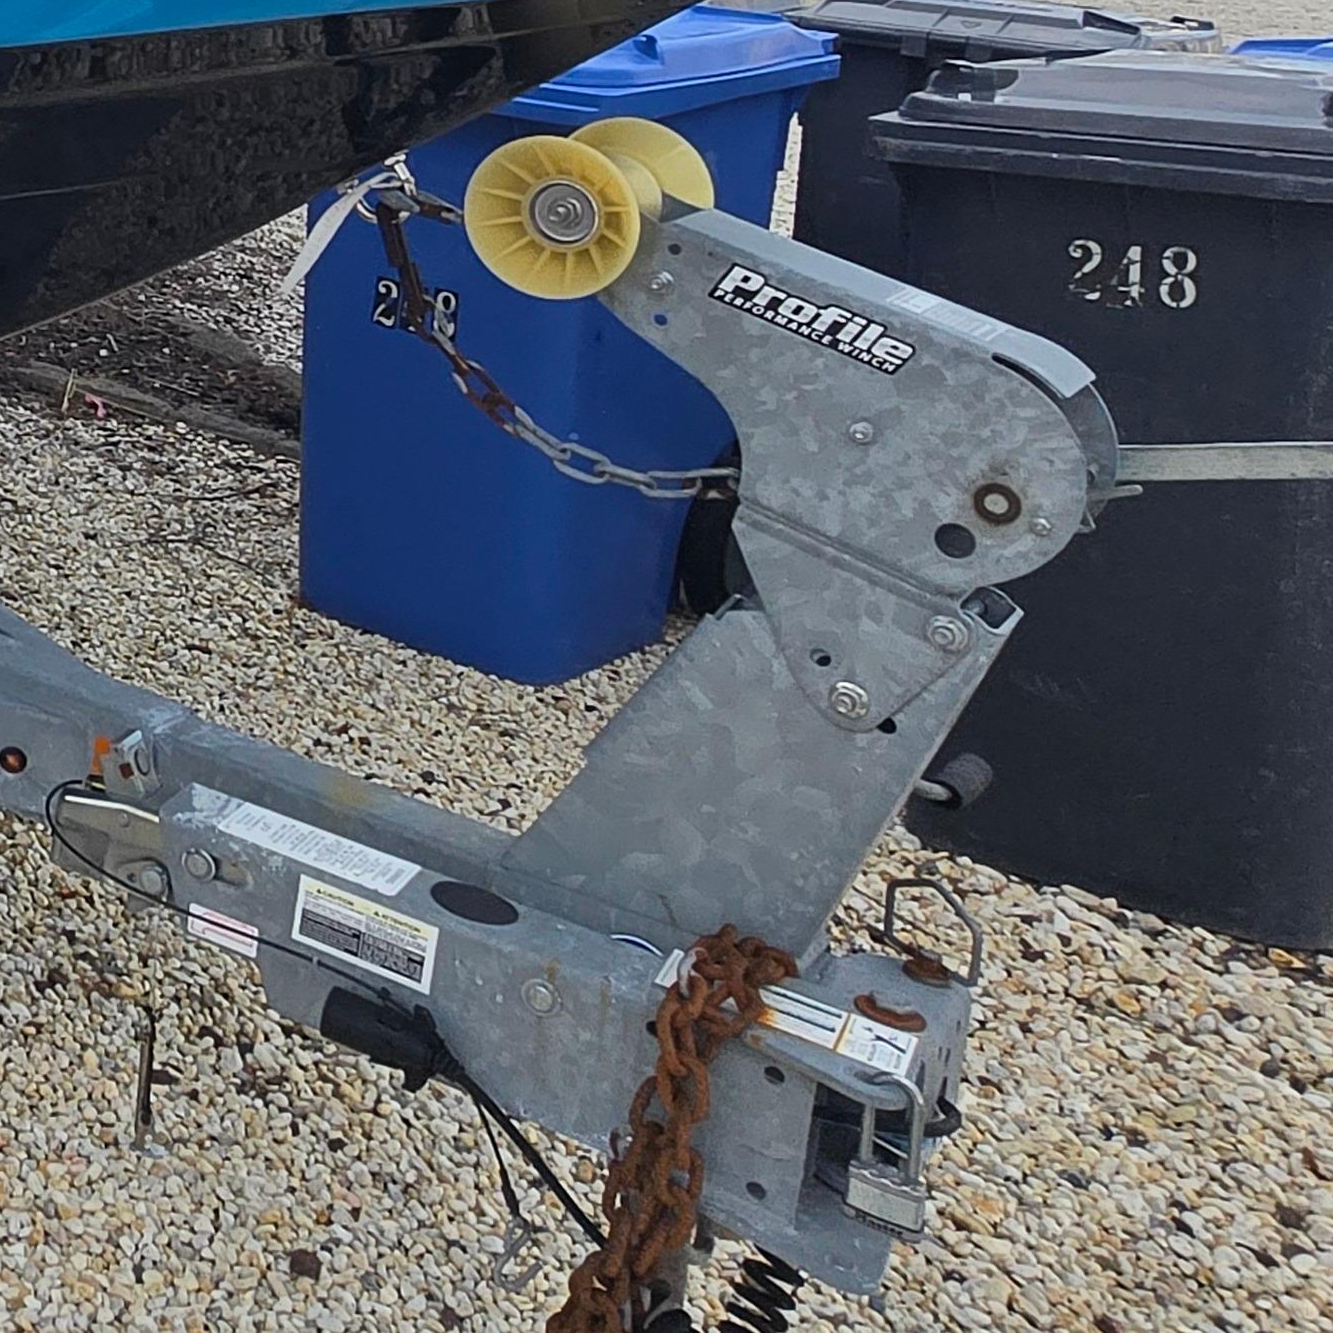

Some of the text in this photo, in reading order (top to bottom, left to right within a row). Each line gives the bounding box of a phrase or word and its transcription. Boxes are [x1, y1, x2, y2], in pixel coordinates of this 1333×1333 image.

[373, 279, 457, 338] 28
[1067, 238, 1198, 309] 248
[713, 288, 834, 345] PERFORMANCE
[837, 342, 897, 373] WINCH
[717, 265, 914, 365] Profile
